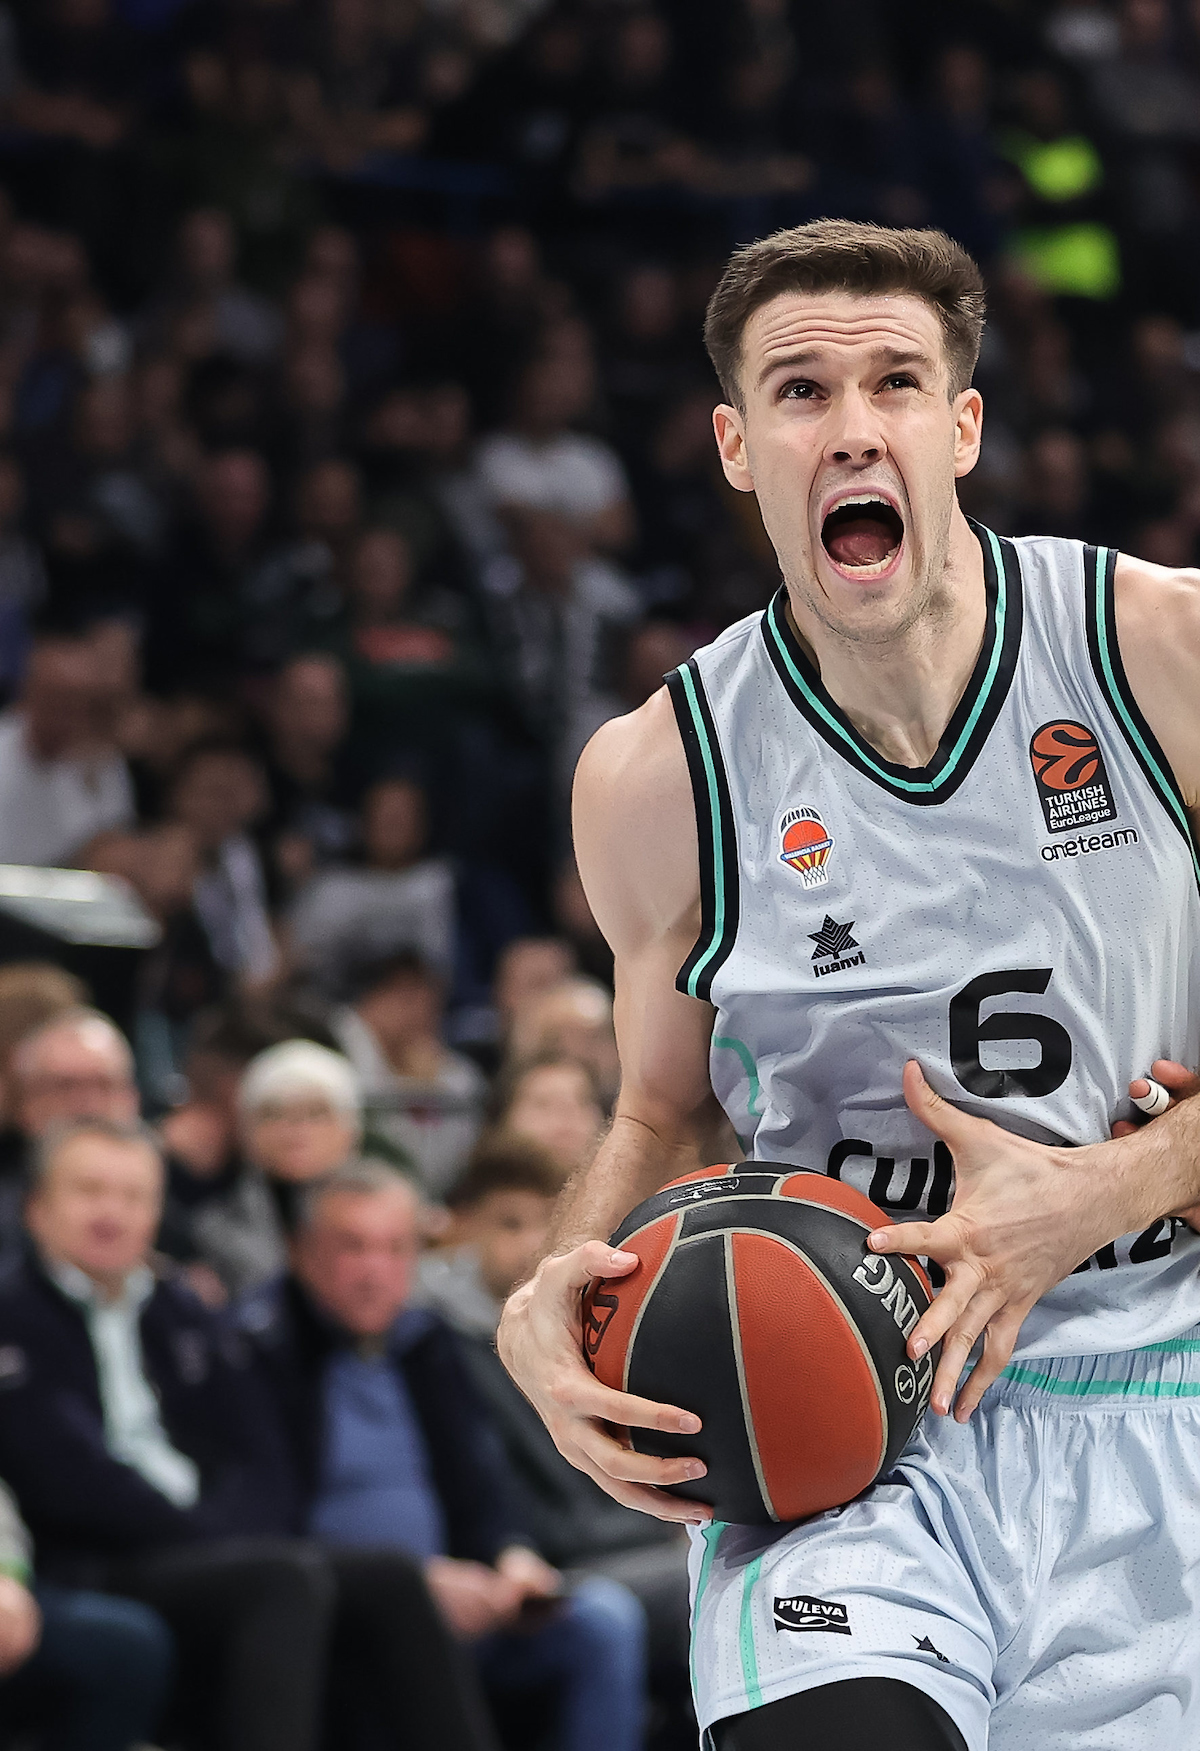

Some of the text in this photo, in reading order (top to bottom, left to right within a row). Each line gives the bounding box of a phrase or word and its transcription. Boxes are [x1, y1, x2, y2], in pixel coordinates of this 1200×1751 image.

[1045, 784, 1105, 807] TURKISH
[1049, 795, 1108, 819] AIRLINES
[1050, 808, 1111, 829] EuroLeague
[1041, 828, 1138, 861] oneteam
[813, 950, 866, 978] luanvi
[949, 968, 1072, 1098] 6
[778, 1600, 845, 1618] PULEVA
